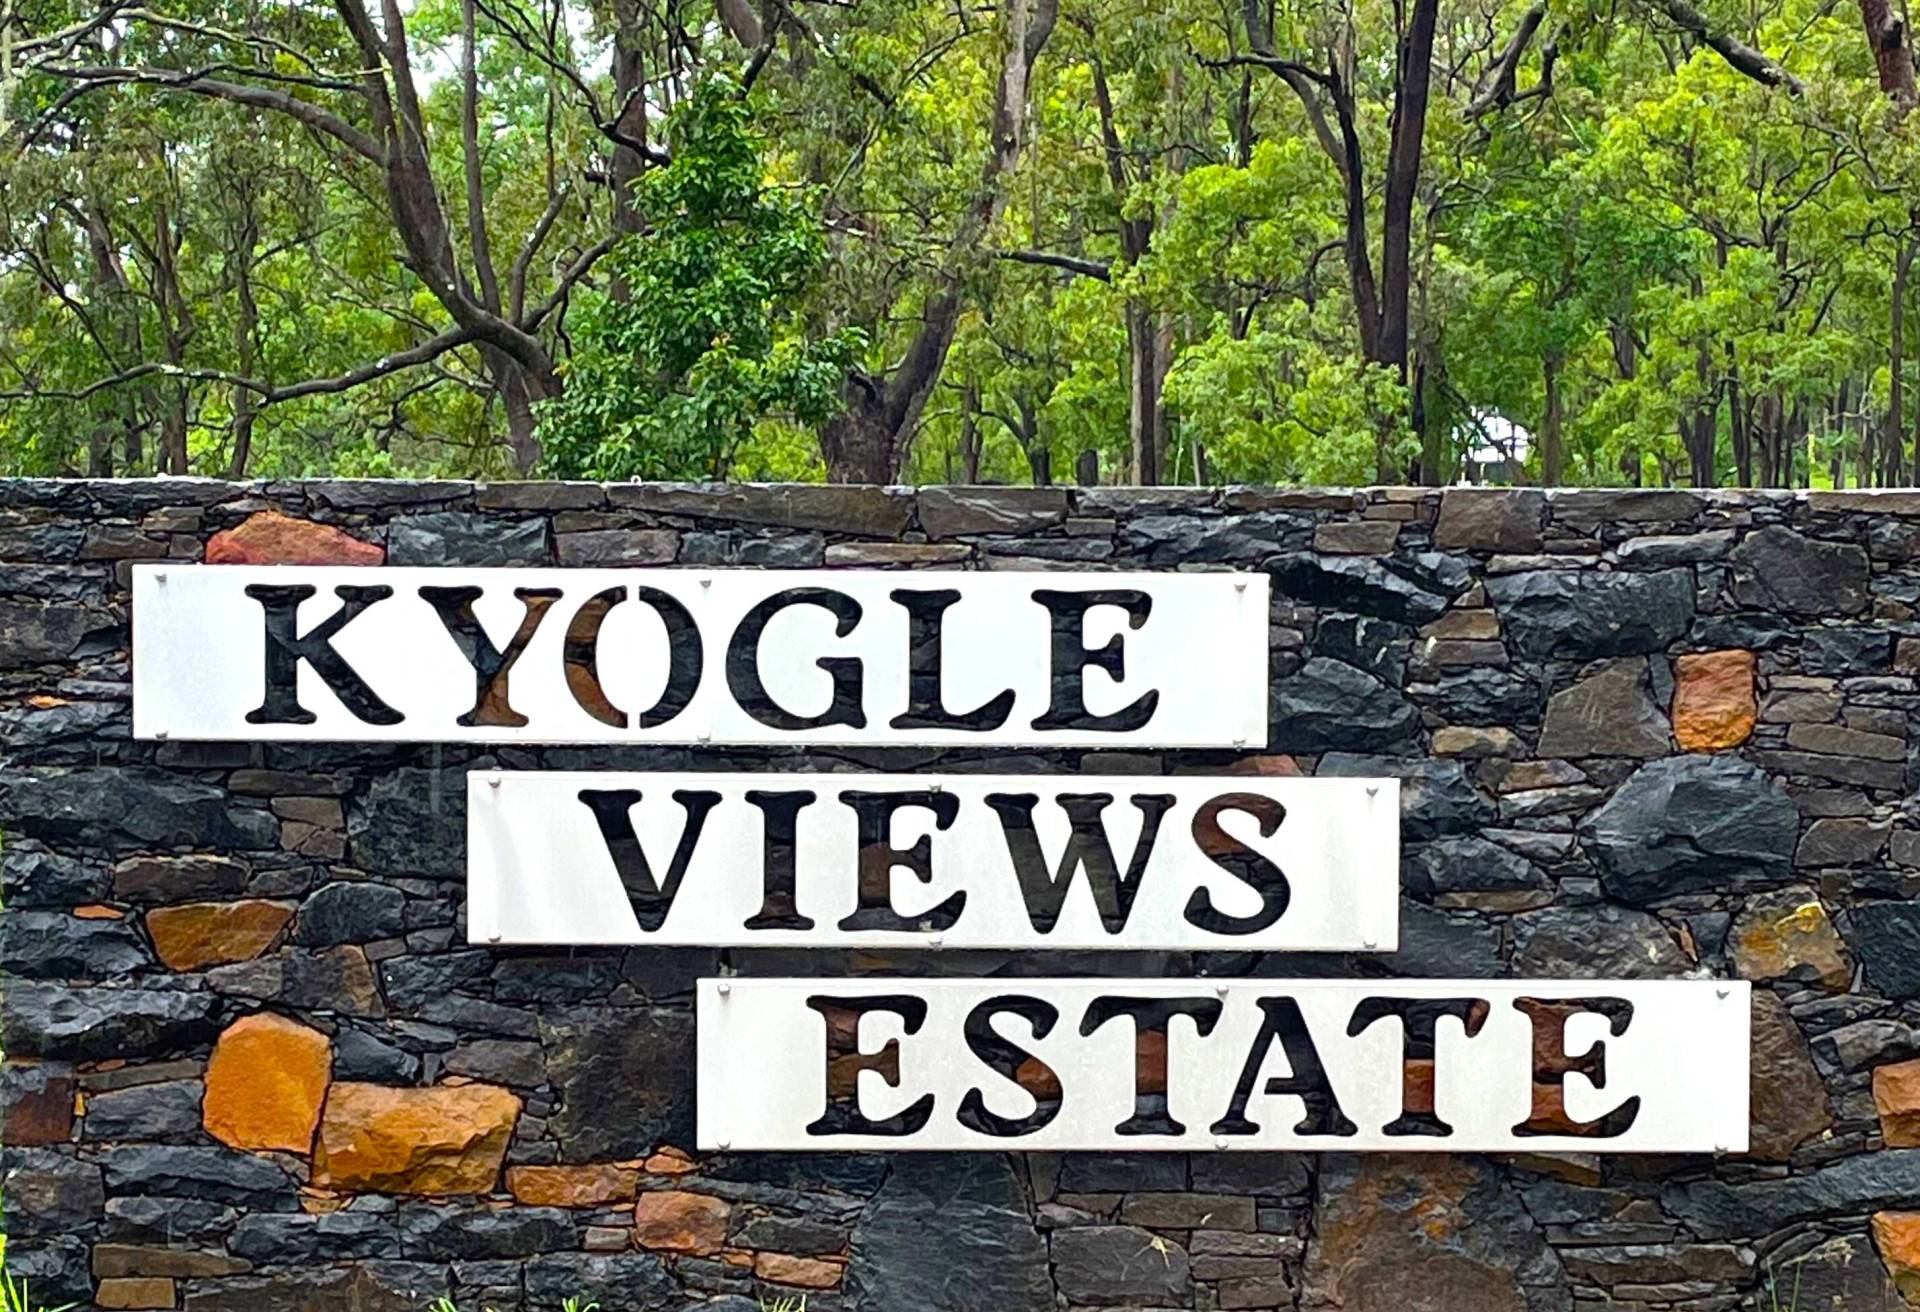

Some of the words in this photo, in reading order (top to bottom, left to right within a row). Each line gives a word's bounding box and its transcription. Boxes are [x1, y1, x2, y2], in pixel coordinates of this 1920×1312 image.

[244, 583, 1160, 733] KYOGLE
[577, 788, 1292, 936] VIEWS
[805, 994, 1641, 1139] ESTATE
